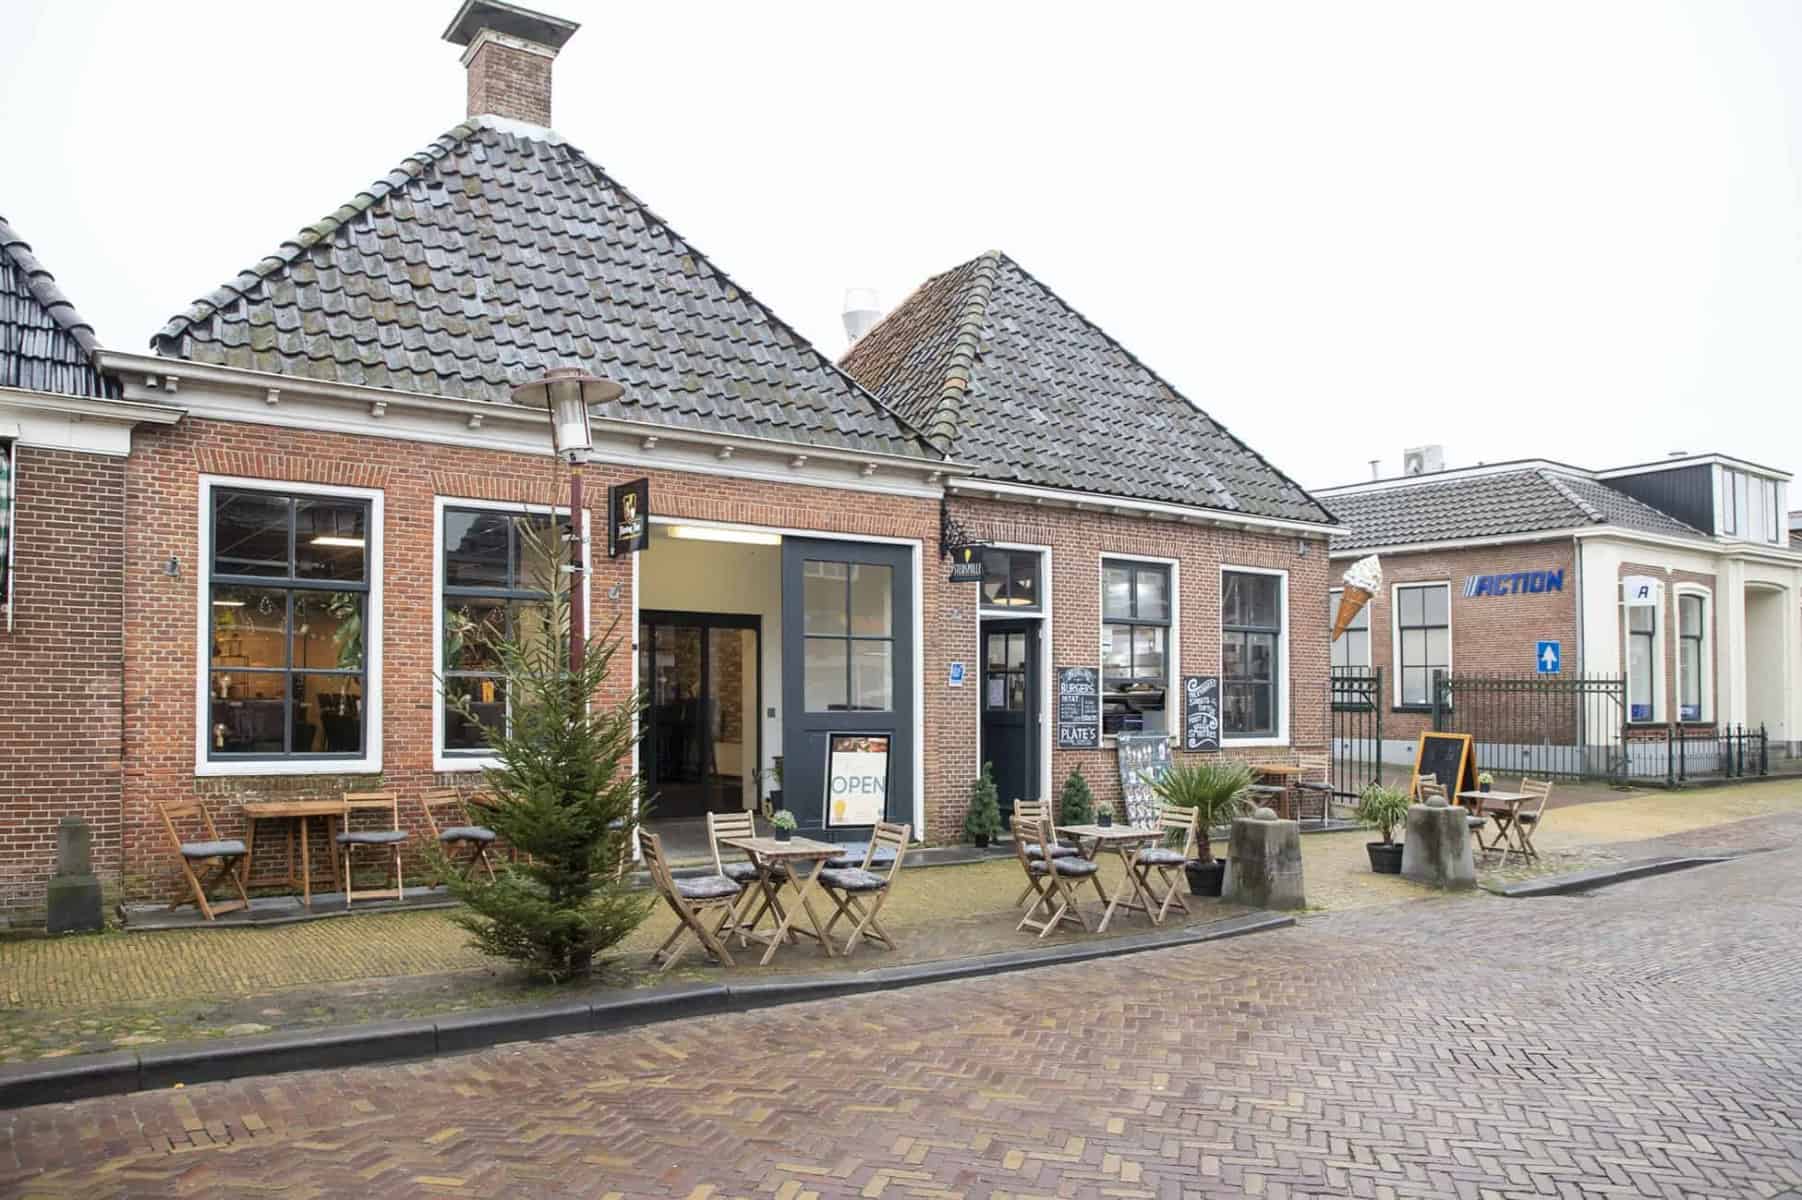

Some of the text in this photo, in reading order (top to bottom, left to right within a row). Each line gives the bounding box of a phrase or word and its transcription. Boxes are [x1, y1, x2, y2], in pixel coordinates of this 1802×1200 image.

[1474, 569, 1564, 596] ACTION
[1061, 727, 1096, 740] PLATE'S
[832, 776, 885, 793] OPEN
